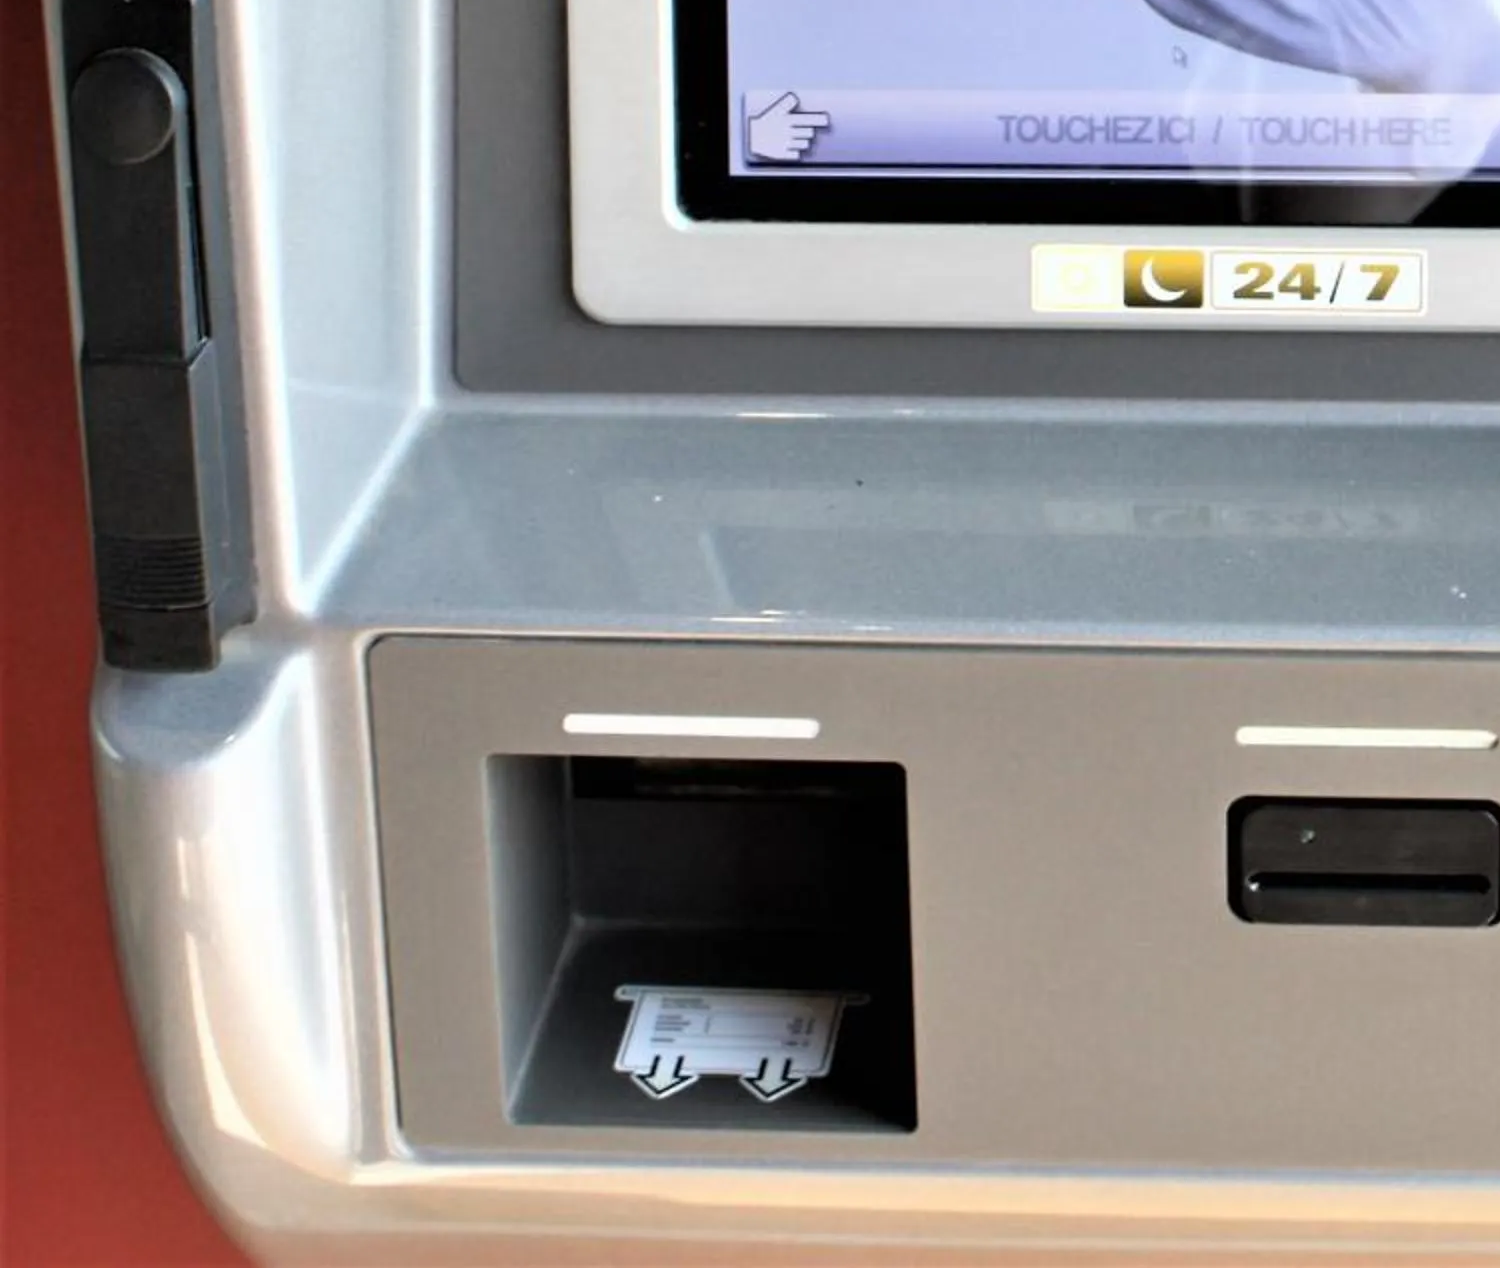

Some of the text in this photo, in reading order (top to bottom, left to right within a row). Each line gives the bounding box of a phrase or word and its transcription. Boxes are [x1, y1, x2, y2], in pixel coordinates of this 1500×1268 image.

[998, 115, 1153, 143] TOUCHEZ
[1159, 115, 1196, 144] ICI
[1238, 117, 1355, 145] TOUCH
[1361, 118, 1453, 145] HERE
[1233, 262, 1400, 303] 24/7
